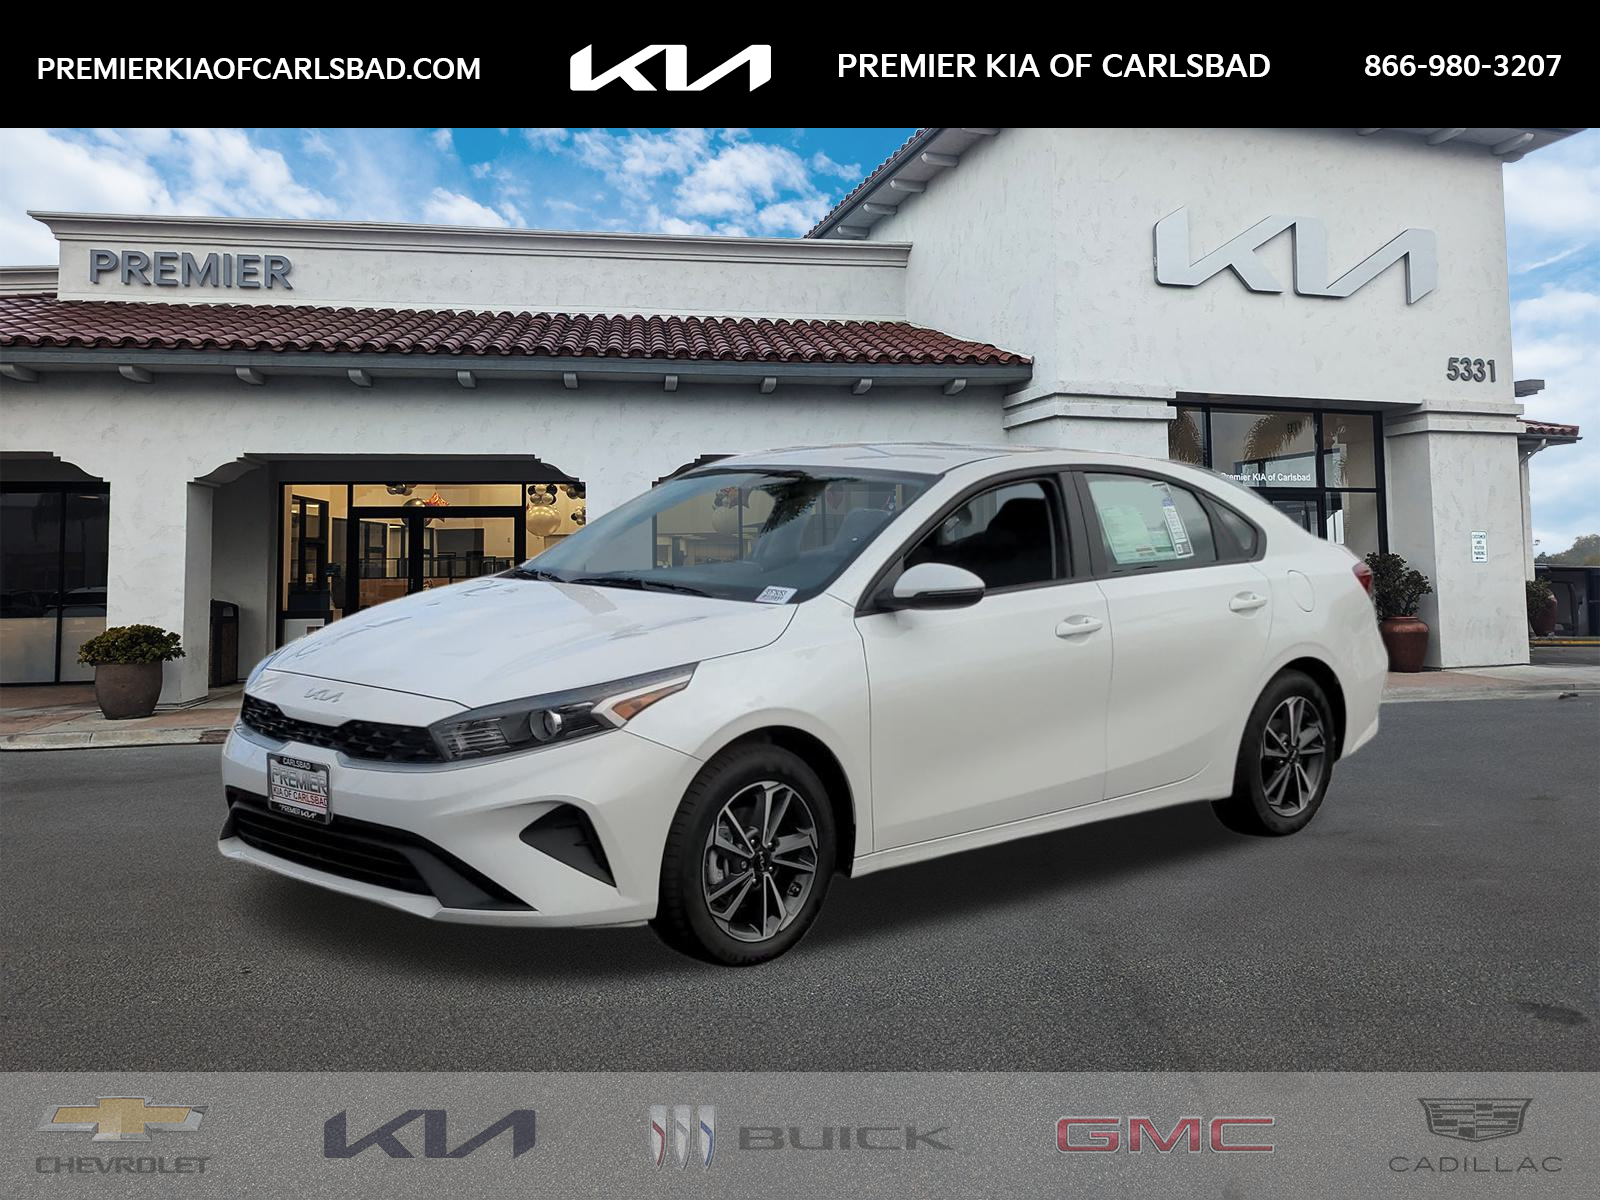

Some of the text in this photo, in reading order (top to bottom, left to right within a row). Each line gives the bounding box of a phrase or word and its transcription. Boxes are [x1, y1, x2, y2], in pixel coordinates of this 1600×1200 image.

[1153, 205, 1437, 305] KIA
[89, 249, 294, 290] PREMIER
[1446, 356, 1496, 383] 5331
[1252, 472, 1266, 481] KIA
[1268, 472, 1276, 481] of
[1277, 473, 1311, 482] Carlsbad
[282, 757, 311, 770] CARLSBAD
[271, 767, 328, 796] PREMIER
